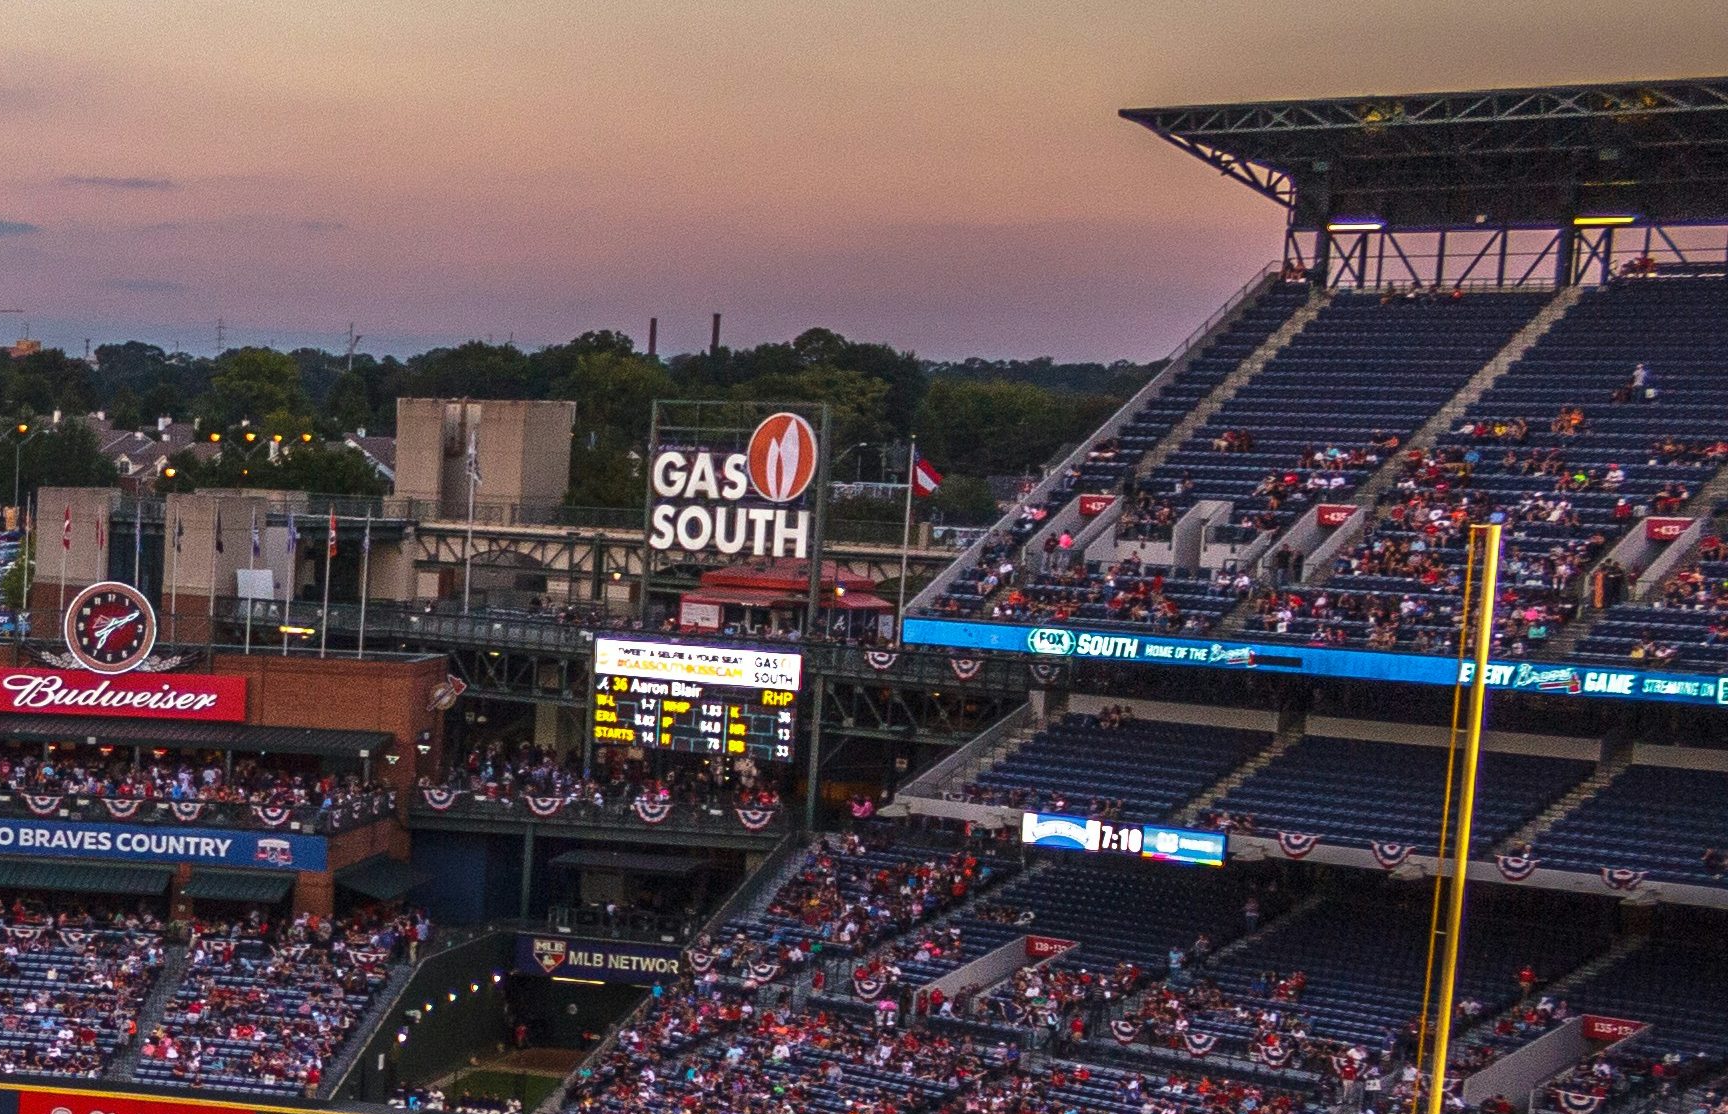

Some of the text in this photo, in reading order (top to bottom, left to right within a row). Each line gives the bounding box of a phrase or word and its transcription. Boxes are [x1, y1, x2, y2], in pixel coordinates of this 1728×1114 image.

[652, 451, 747, 501] GAS
[649, 505, 810, 559] SOUTH
[1039, 631, 1138, 658] FOX SOUTH
[1459, 663, 1516, 685] EERY
[1584, 672, 1635, 695] GAME
[2, 674, 216, 712] Budweiser
[18, 828, 111, 851] BRAVES
[116, 834, 232, 858] COUNTRY
[1102, 825, 1142, 853] 7:10
[569, 951, 679, 974] MLB NETWOR
